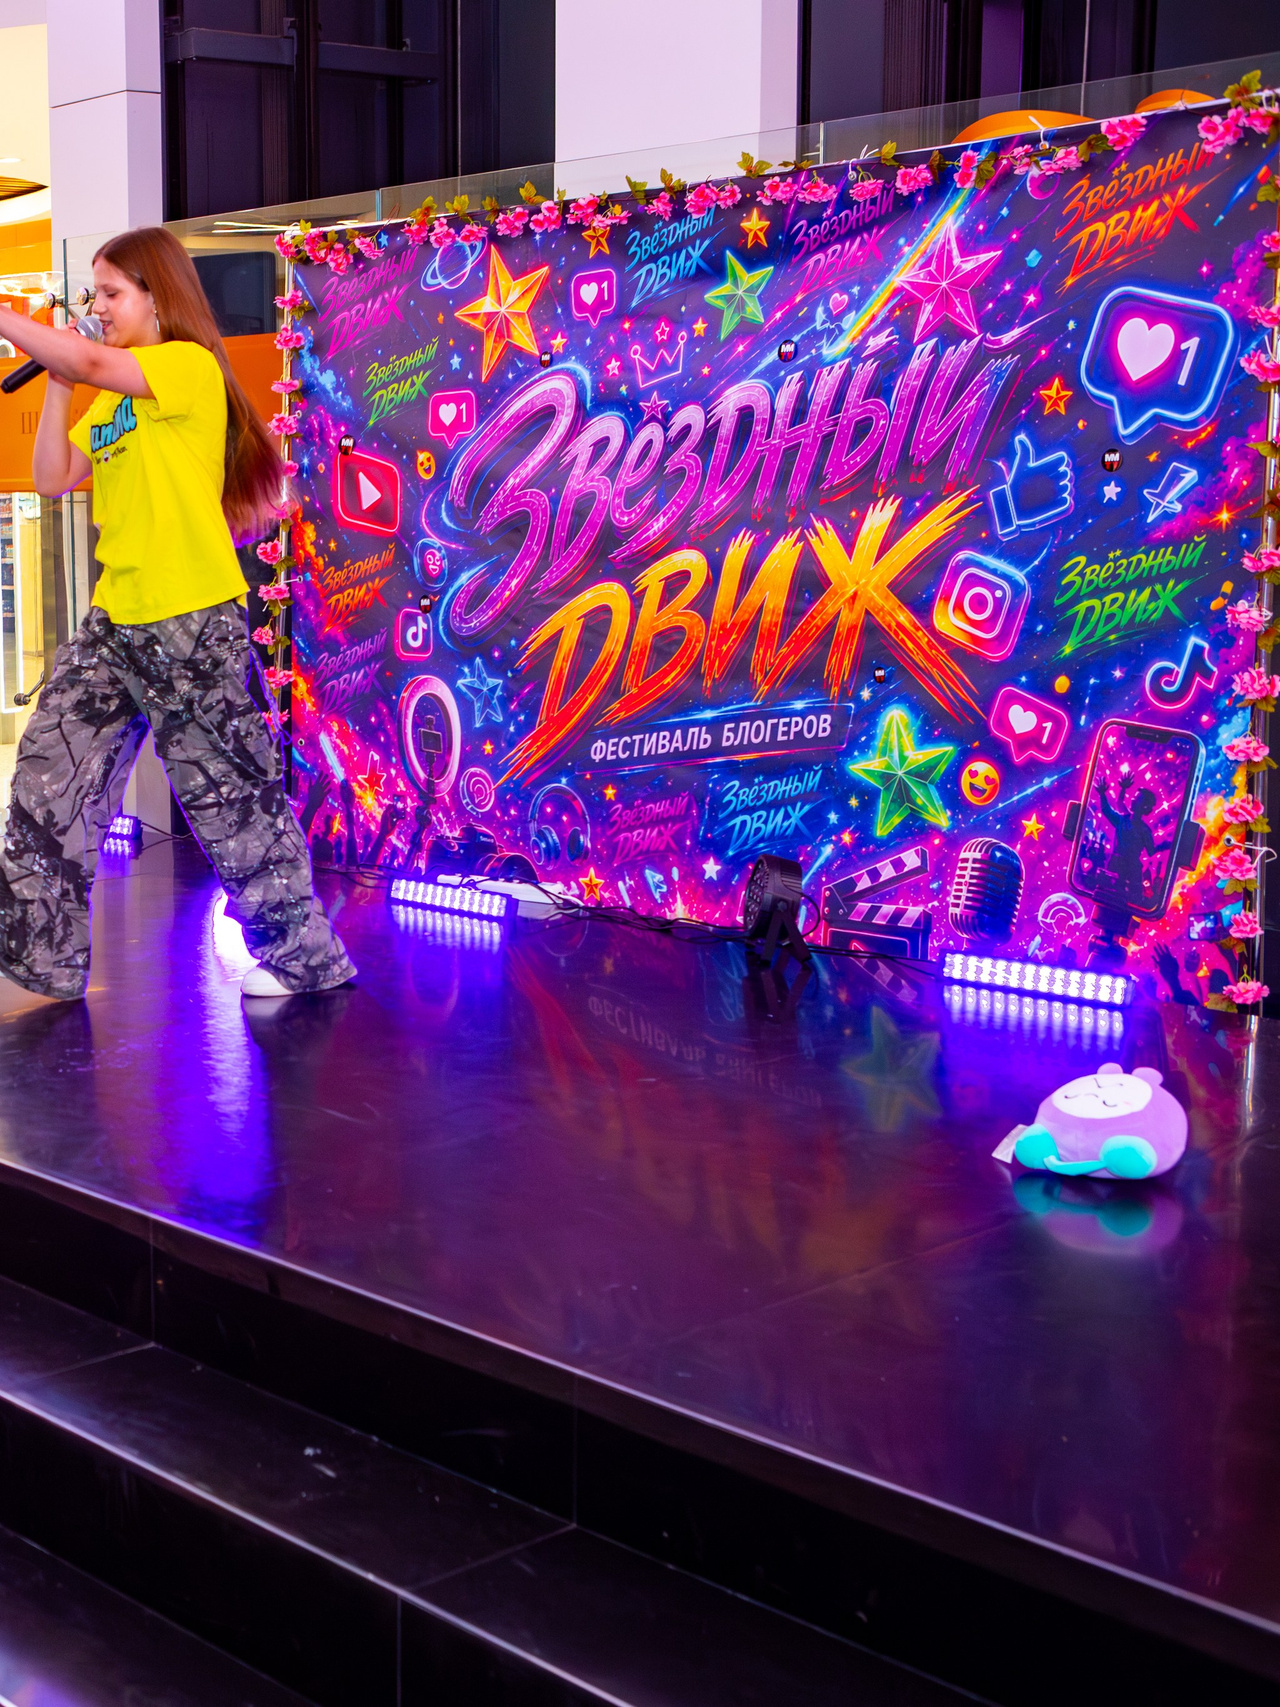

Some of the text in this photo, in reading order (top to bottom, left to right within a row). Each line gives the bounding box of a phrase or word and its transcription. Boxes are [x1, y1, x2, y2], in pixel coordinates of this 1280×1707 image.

[795, 225, 888, 298] ДВИЖ
[1057, 183, 1204, 288] ДВИЖ
[601, 281, 608, 301] 1
[626, 237, 716, 310] ДВИЖ
[322, 280, 410, 361] ДВИЖ
[1179, 336, 1200, 387] 1
[365, 369, 431, 427] ДВИЖ
[459, 406, 467, 424] 1
[323, 576, 391, 634] ДВИЖ
[1056, 578, 1195, 657] ДВИЖ
[492, 485, 986, 790] ДВИЖ
[320, 660, 387, 718] ДВИЖ
[589, 713, 832, 763] ФЕСТИВАЛЬ БЛОГЕРОВ
[1041, 721, 1053, 746] 1
[612, 821, 685, 866] ДВИЖ
[722, 800, 816, 856] ДВИЖ
